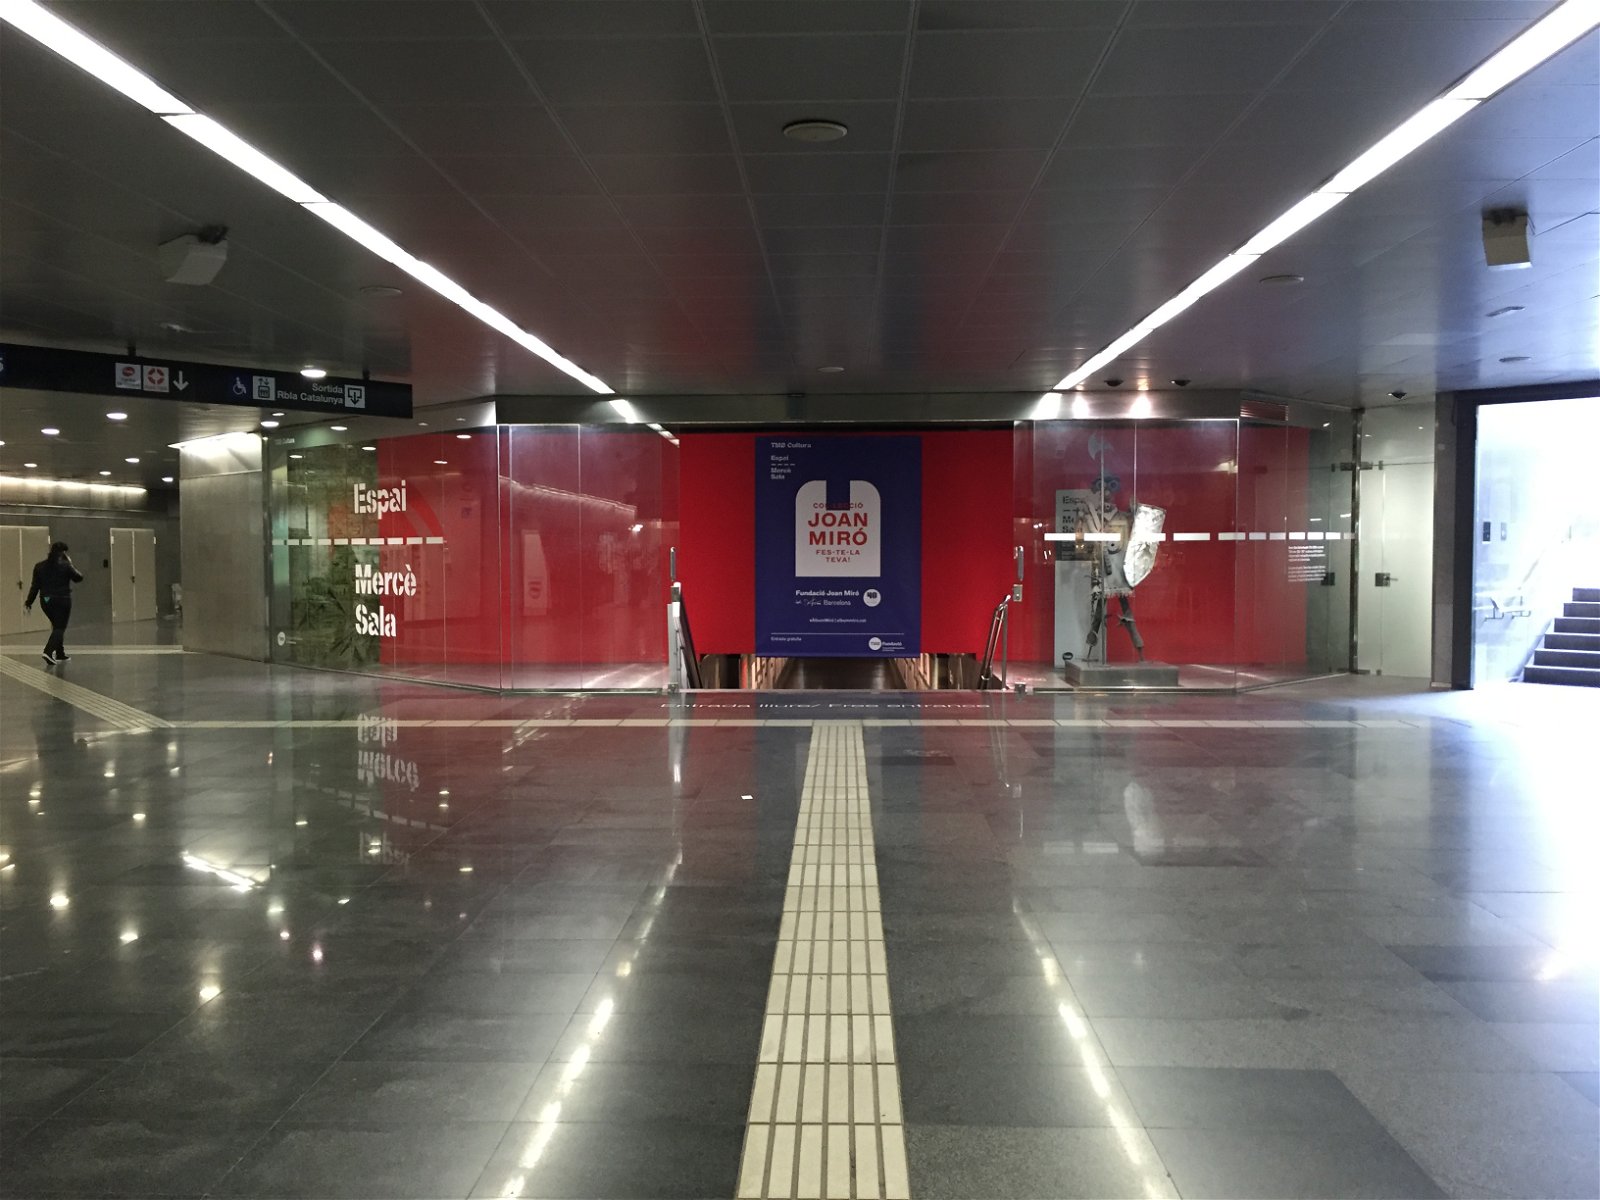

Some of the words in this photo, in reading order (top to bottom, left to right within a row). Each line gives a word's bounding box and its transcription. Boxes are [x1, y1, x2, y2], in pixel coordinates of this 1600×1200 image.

[277, 390, 298, 400] Rbla
[300, 392, 344, 405] Catalunya
[312, 382, 343, 394] Sortida
[353, 479, 407, 520] Espai
[807, 512, 868, 527] JOAN
[808, 527, 868, 546] MIRÓ
[355, 563, 417, 597] Mercè
[355, 603, 397, 637] Sala
